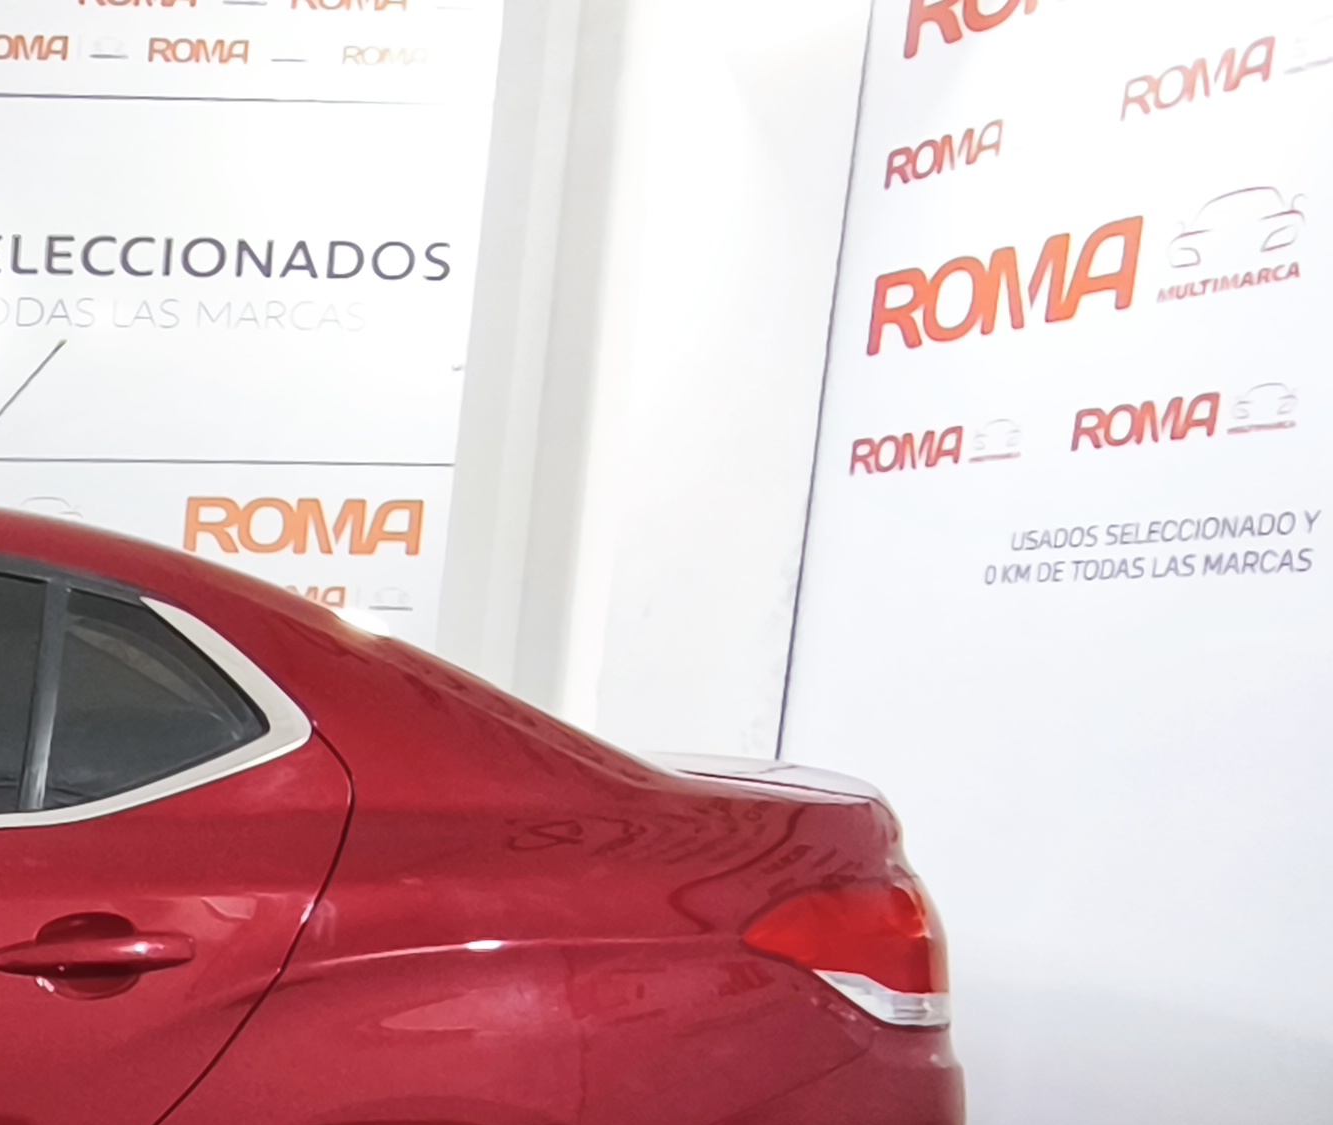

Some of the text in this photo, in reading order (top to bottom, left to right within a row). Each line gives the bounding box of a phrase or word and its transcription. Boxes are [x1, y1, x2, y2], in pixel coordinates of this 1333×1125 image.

[148, 38, 249, 64] ROMA
[342, 45, 426, 66] ROMA
[1121, 36, 1276, 121] ROMA
[884, 119, 1004, 190] ROMA
[113, 298, 180, 329] LAS
[197, 301, 365, 331] MARCAS
[866, 215, 1301, 357] ROMA MULTIMARCA
[849, 391, 1221, 476] ROMA ROMA
[183, 496, 425, 556] ROMA
[1011, 510, 1322, 551] USADOS SELECCIONADO Y
[1001, 564, 1032, 584] KM
[1037, 561, 1066, 583] DE
[1072, 557, 1146, 582] TODAS
[1151, 554, 1197, 579] LAS
[1202, 548, 1315, 576] MARCAS
